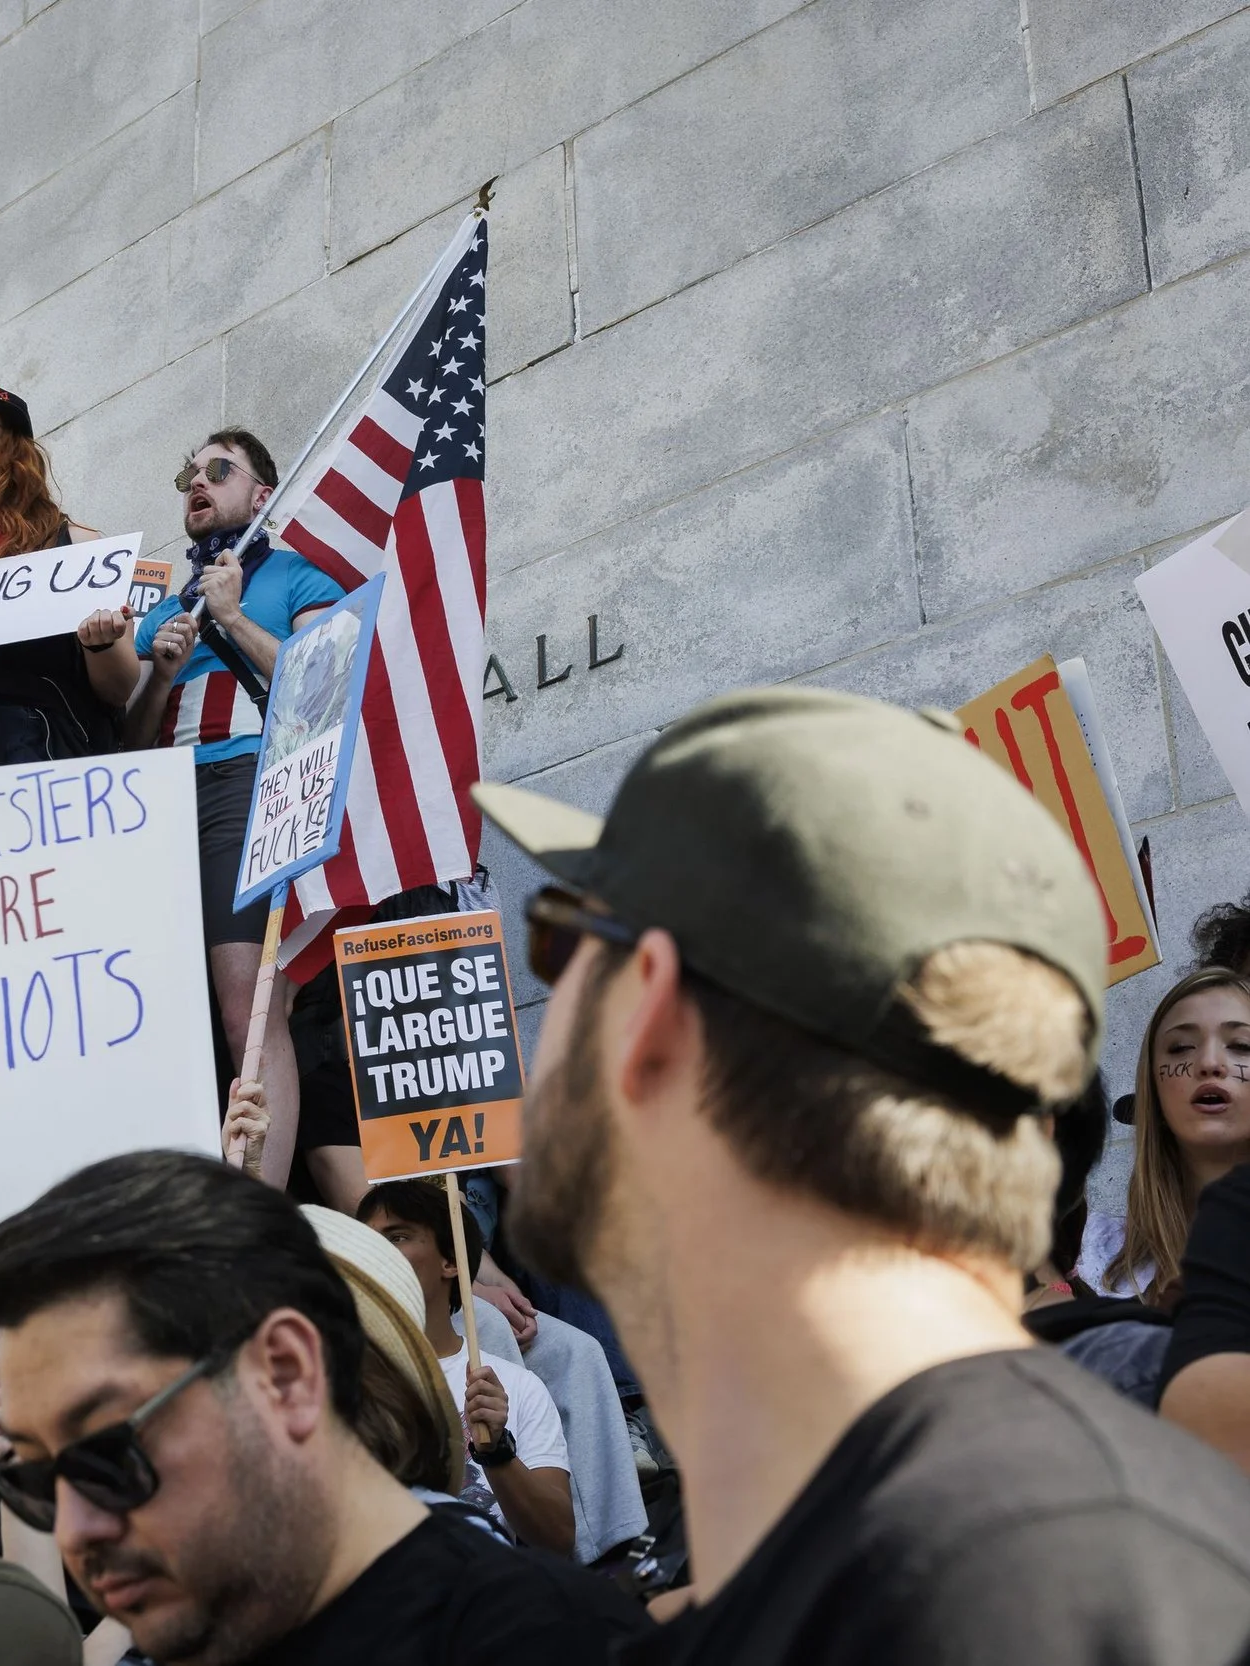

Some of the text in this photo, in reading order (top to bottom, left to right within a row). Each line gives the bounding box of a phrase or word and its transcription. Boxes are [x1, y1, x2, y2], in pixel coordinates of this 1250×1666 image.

[50, 549, 133, 595] US
[259, 741, 338, 804] THEY WILL
[264, 768, 326, 824] KILL US
[248, 814, 301, 885] FUCK
[343, 923, 493, 956] RefuseFascism.org
[352, 954, 500, 1016] ¡QUE SE
[355, 1000, 508, 1058] LARGUE
[367, 1050, 506, 1104] TRUMP
[1159, 1062, 1194, 1082] FUCK
[409, 1112, 485, 1162] YA!
